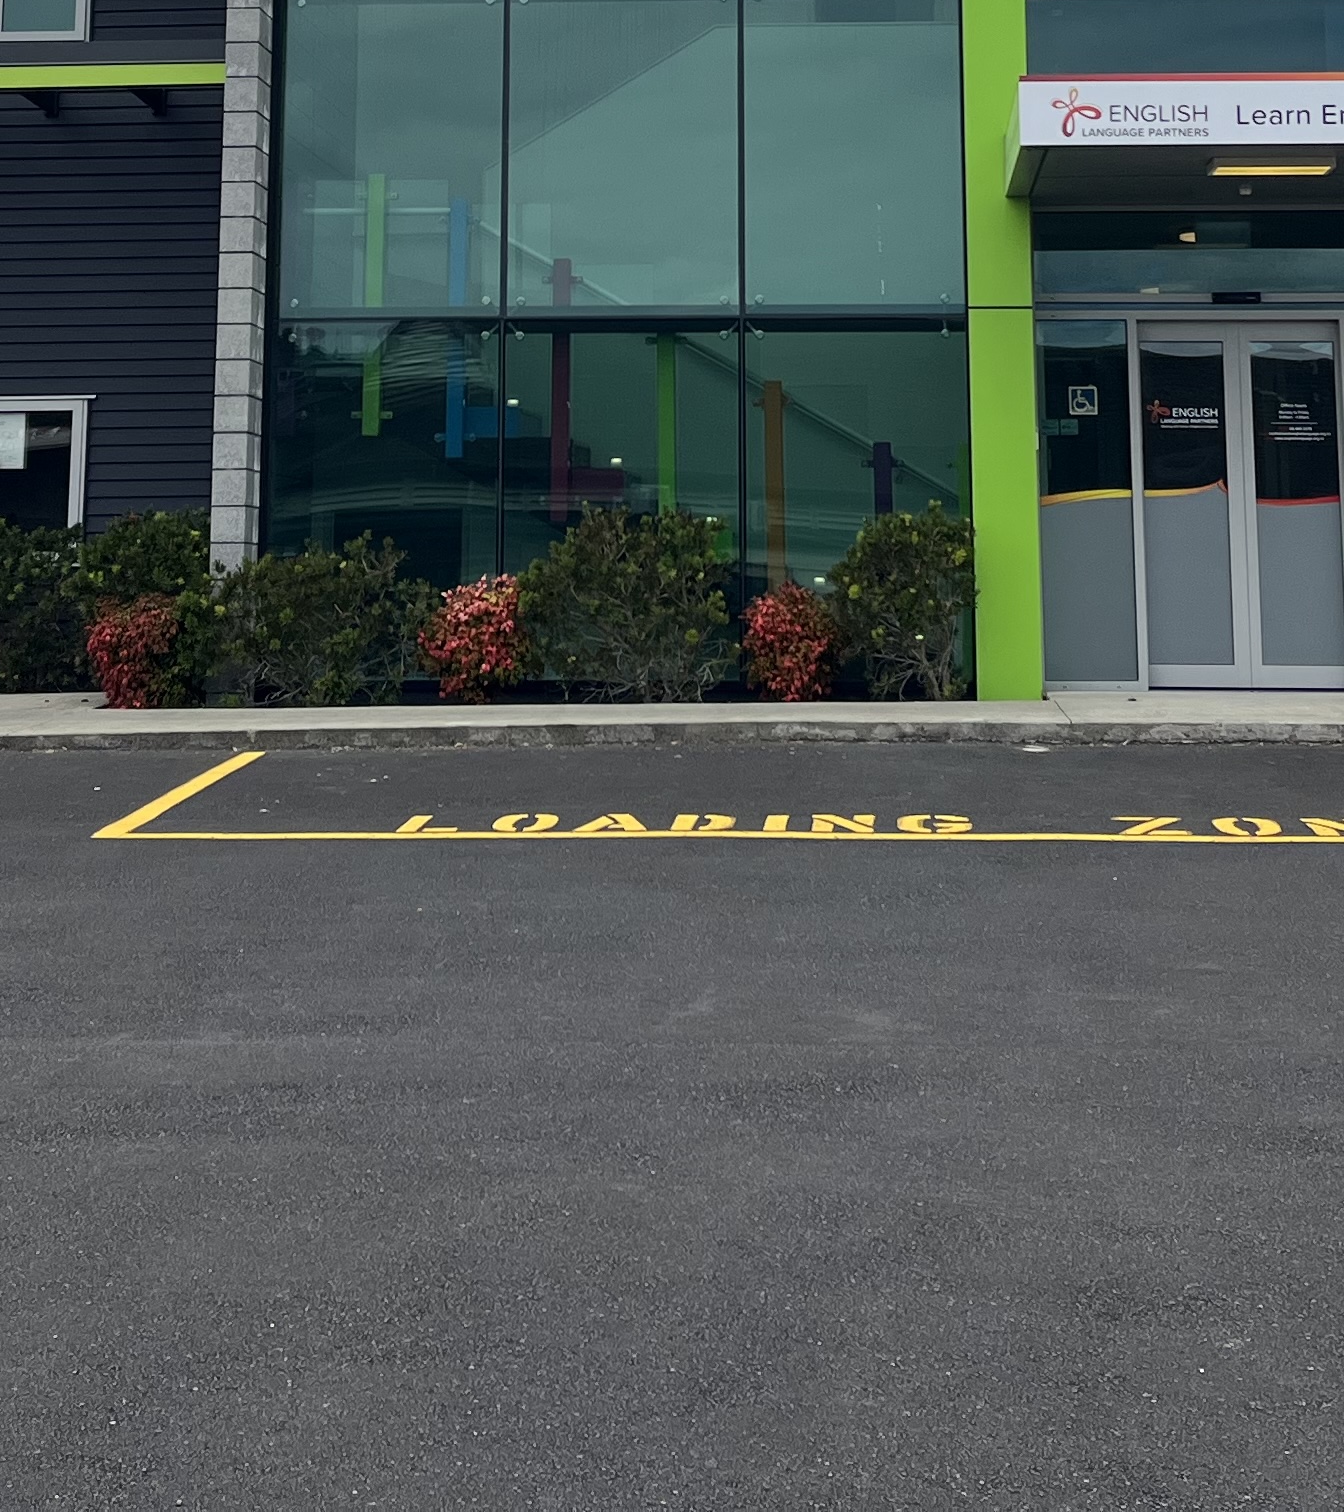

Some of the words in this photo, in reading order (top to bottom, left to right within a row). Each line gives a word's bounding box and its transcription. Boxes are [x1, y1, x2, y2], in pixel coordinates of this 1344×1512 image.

[1109, 104, 1208, 123] ENGLISH
[1236, 104, 1311, 125] Learn
[1081, 127, 1145, 138] LANGUAGE
[1148, 127, 1209, 138] PARTNERS
[1171, 407, 1219, 418] ENGLISH
[394, 813, 973, 834] LOADING
